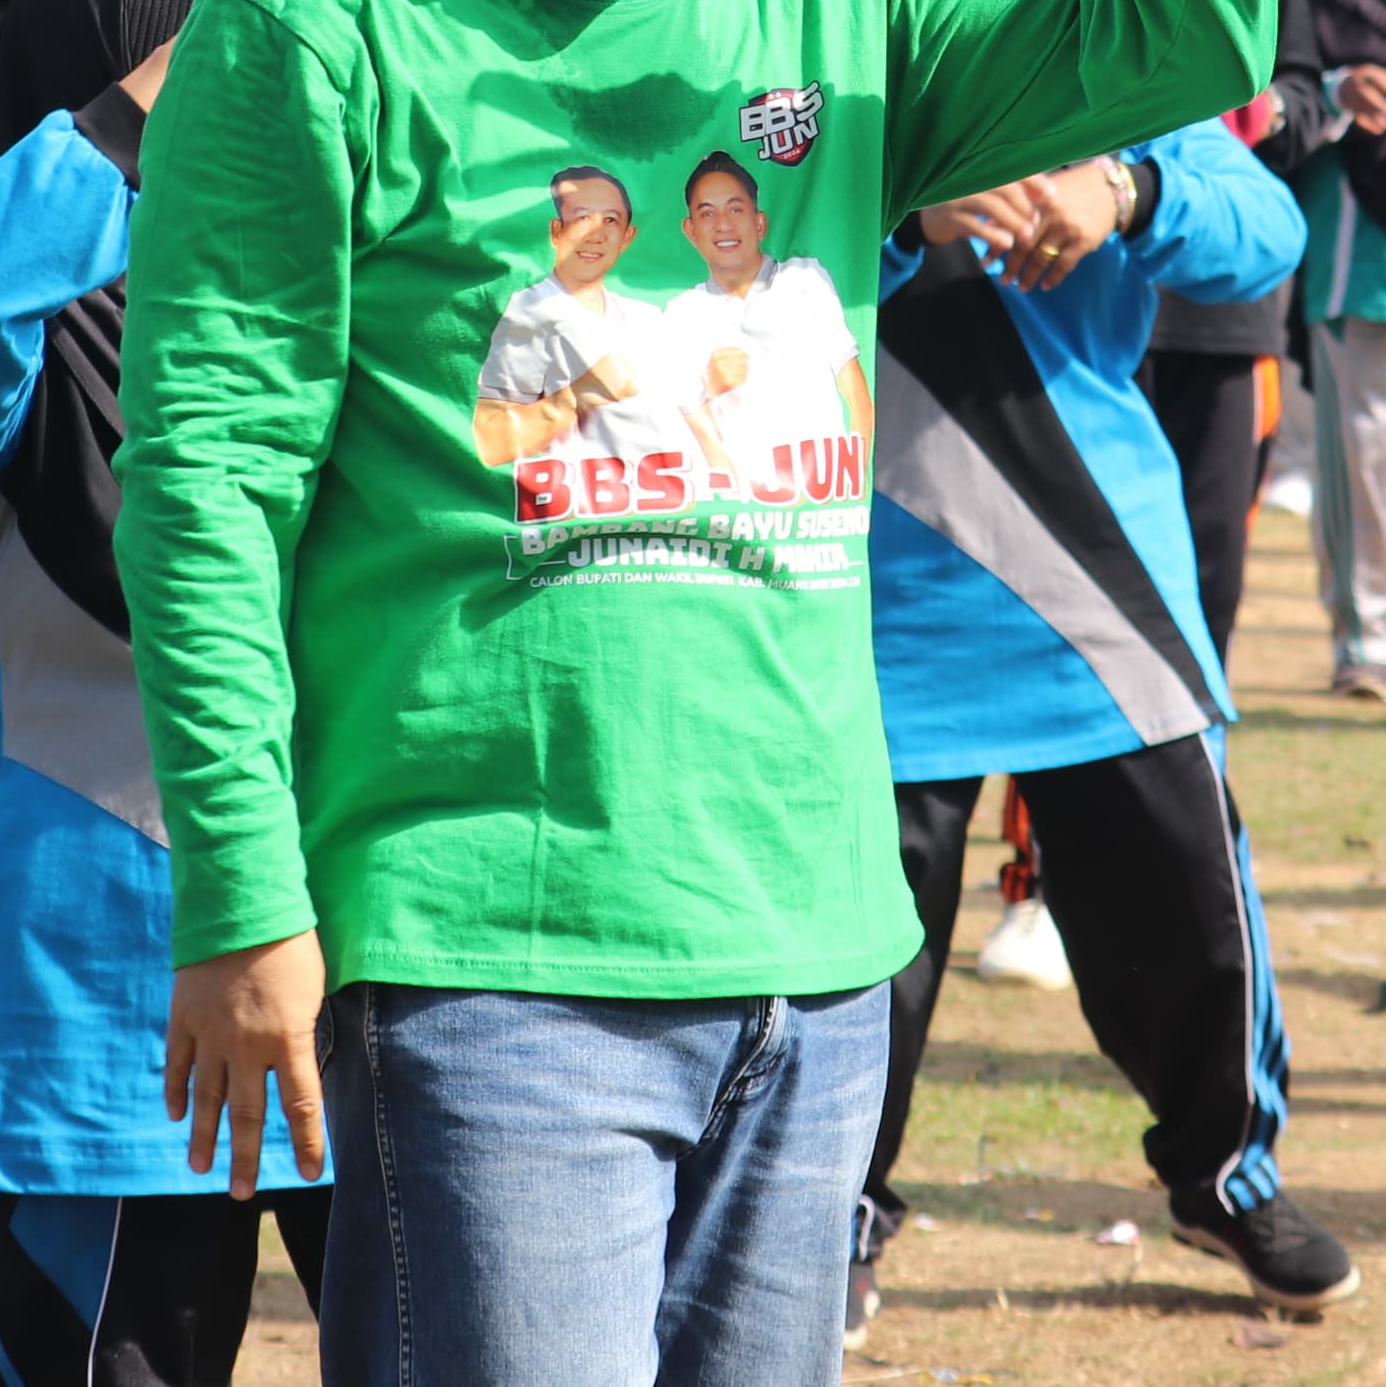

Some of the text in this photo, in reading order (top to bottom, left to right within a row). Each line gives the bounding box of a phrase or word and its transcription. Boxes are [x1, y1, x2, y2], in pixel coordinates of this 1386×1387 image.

[739, 81, 824, 141] BBS
[758, 116, 819, 159] JUN
[516, 451, 686, 522] BBS
[750, 434, 860, 504] JUN
[708, 510, 794, 540] BAYU
[568, 537, 734, 568] JUNAIDI
[530, 574, 576, 588] CALON
[577, 572, 622, 584] BUPATI
[625, 572, 652, 584] DAN
[655, 571, 694, 584] WAKIL
